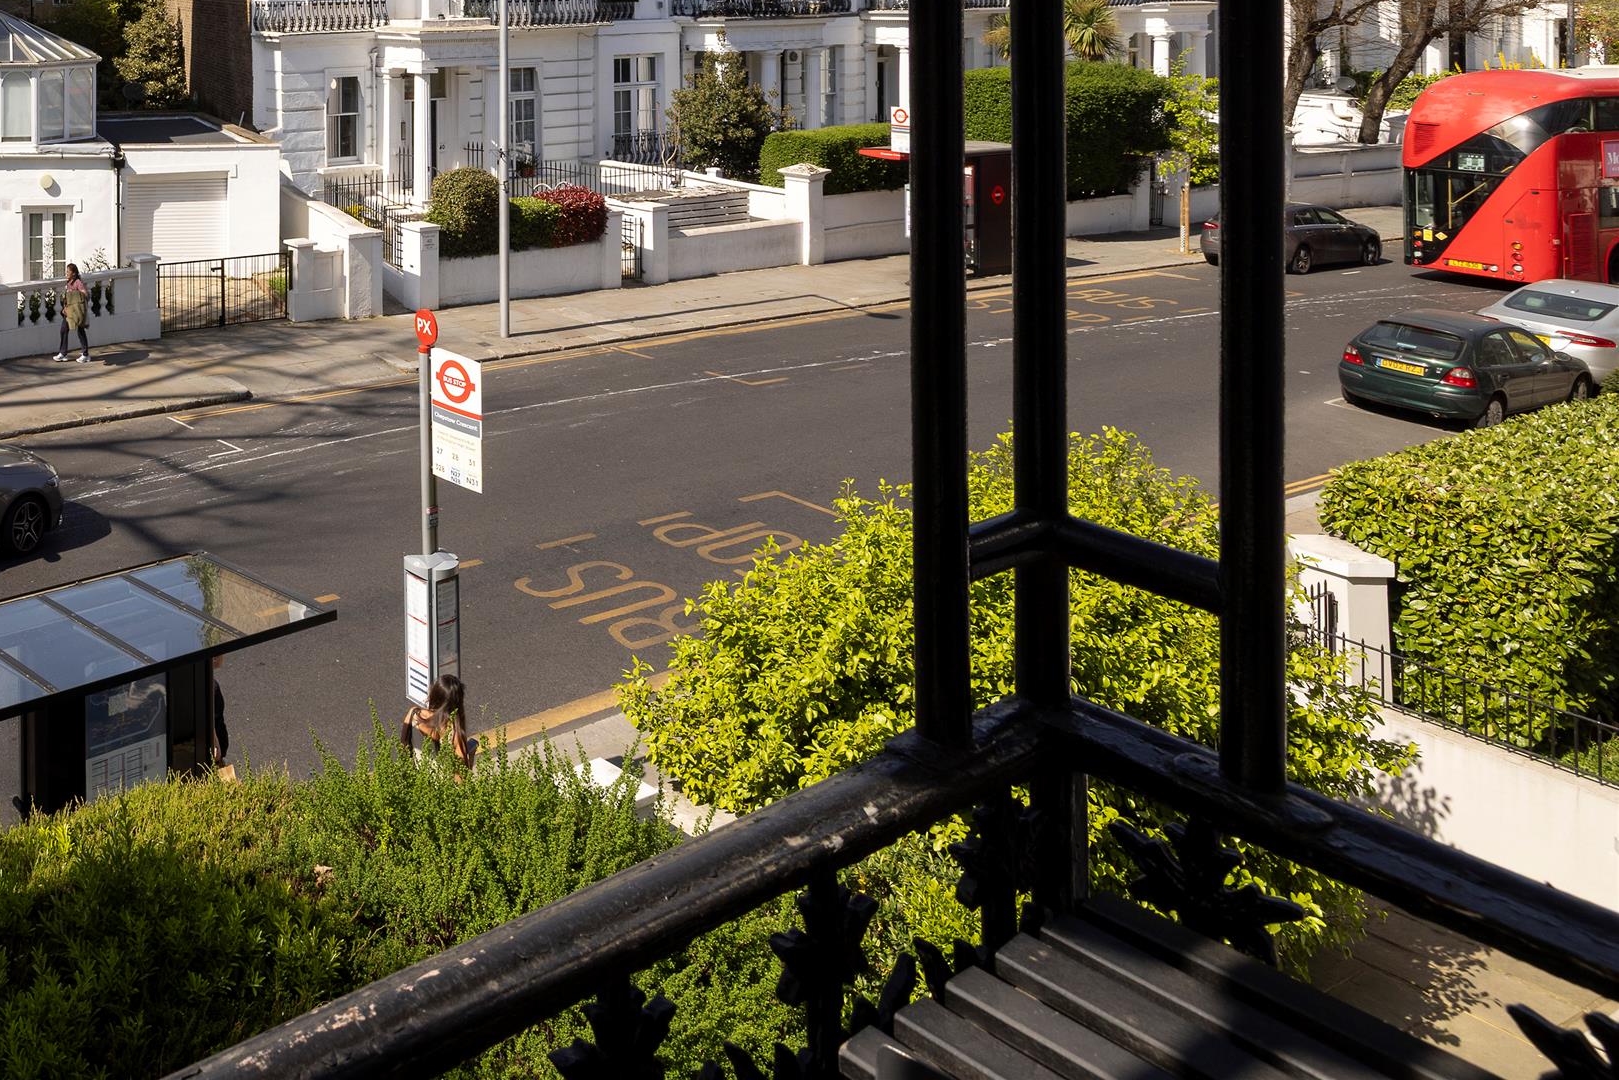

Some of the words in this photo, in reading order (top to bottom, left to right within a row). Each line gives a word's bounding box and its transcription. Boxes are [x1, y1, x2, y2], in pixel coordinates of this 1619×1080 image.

[417, 317, 432, 336] PX
[443, 375, 453, 384] BUS
[452, 378, 467, 388] STOP
[456, 419, 478, 432] Crescent
[436, 446, 443, 455] 27
[468, 458, 476, 467] 31
[466, 476, 479, 487] N31
[514, 560, 703, 650] BUS
